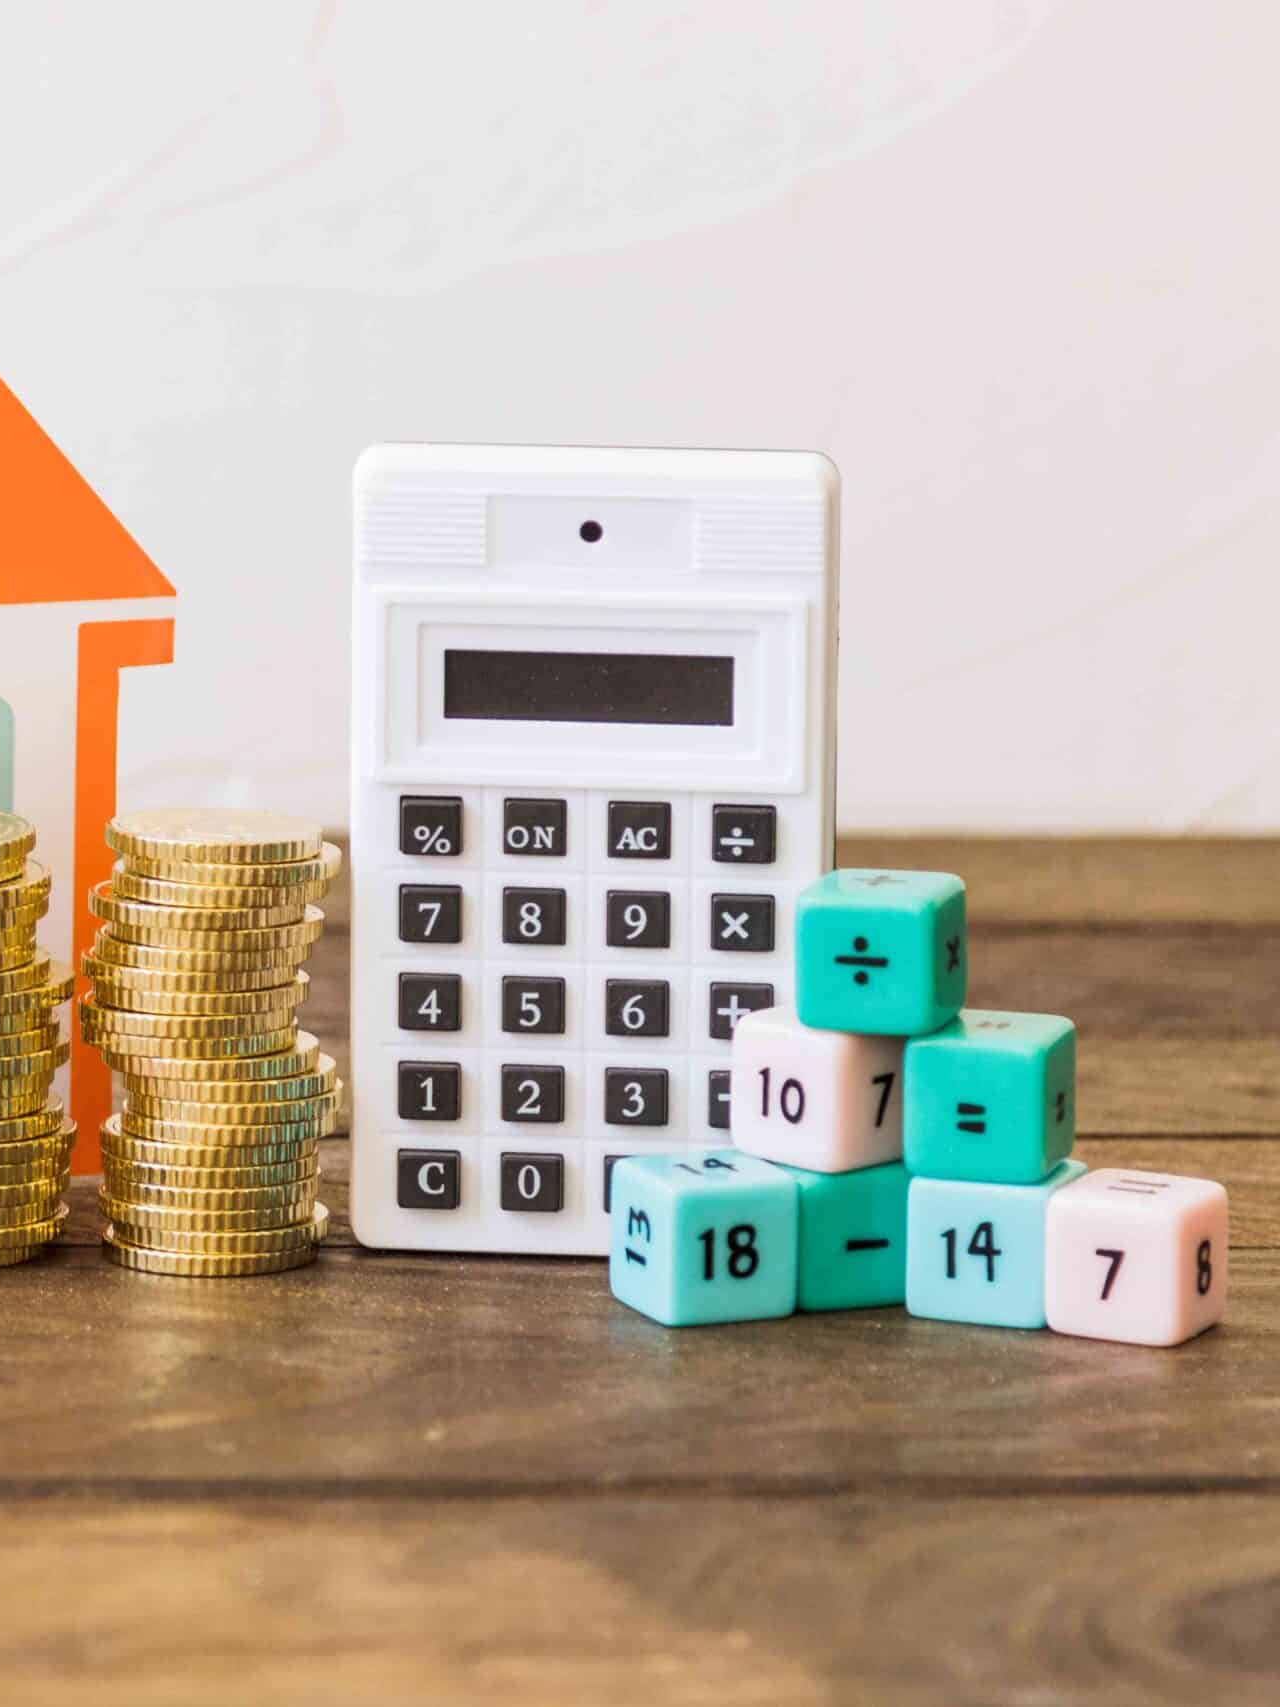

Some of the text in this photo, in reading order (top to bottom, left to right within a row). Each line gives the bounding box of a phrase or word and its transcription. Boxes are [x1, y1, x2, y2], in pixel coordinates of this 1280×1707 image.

[506, 825, 555, 849] ON
[615, 826, 658, 851] AC
[418, 902, 442, 937] 7
[519, 902, 542, 937] 8
[623, 904, 647, 940] 9
[417, 989, 442, 1024] 4
[519, 992, 541, 1027] 5
[622, 994, 645, 1029] 6
[420, 1077, 437, 1111] 1
[516, 1079, 541, 1115] 2
[621, 1082, 645, 1117] 3
[759, 1067, 805, 1125] 10
[417, 1161, 445, 1195] C
[517, 1164, 541, 1199] 0
[698, 1223, 760, 1281] 18
[940, 1221, 1002, 1283] 14
[1196, 1239, 1212, 1297] 8
[1095, 1248, 1125, 1301] 7
